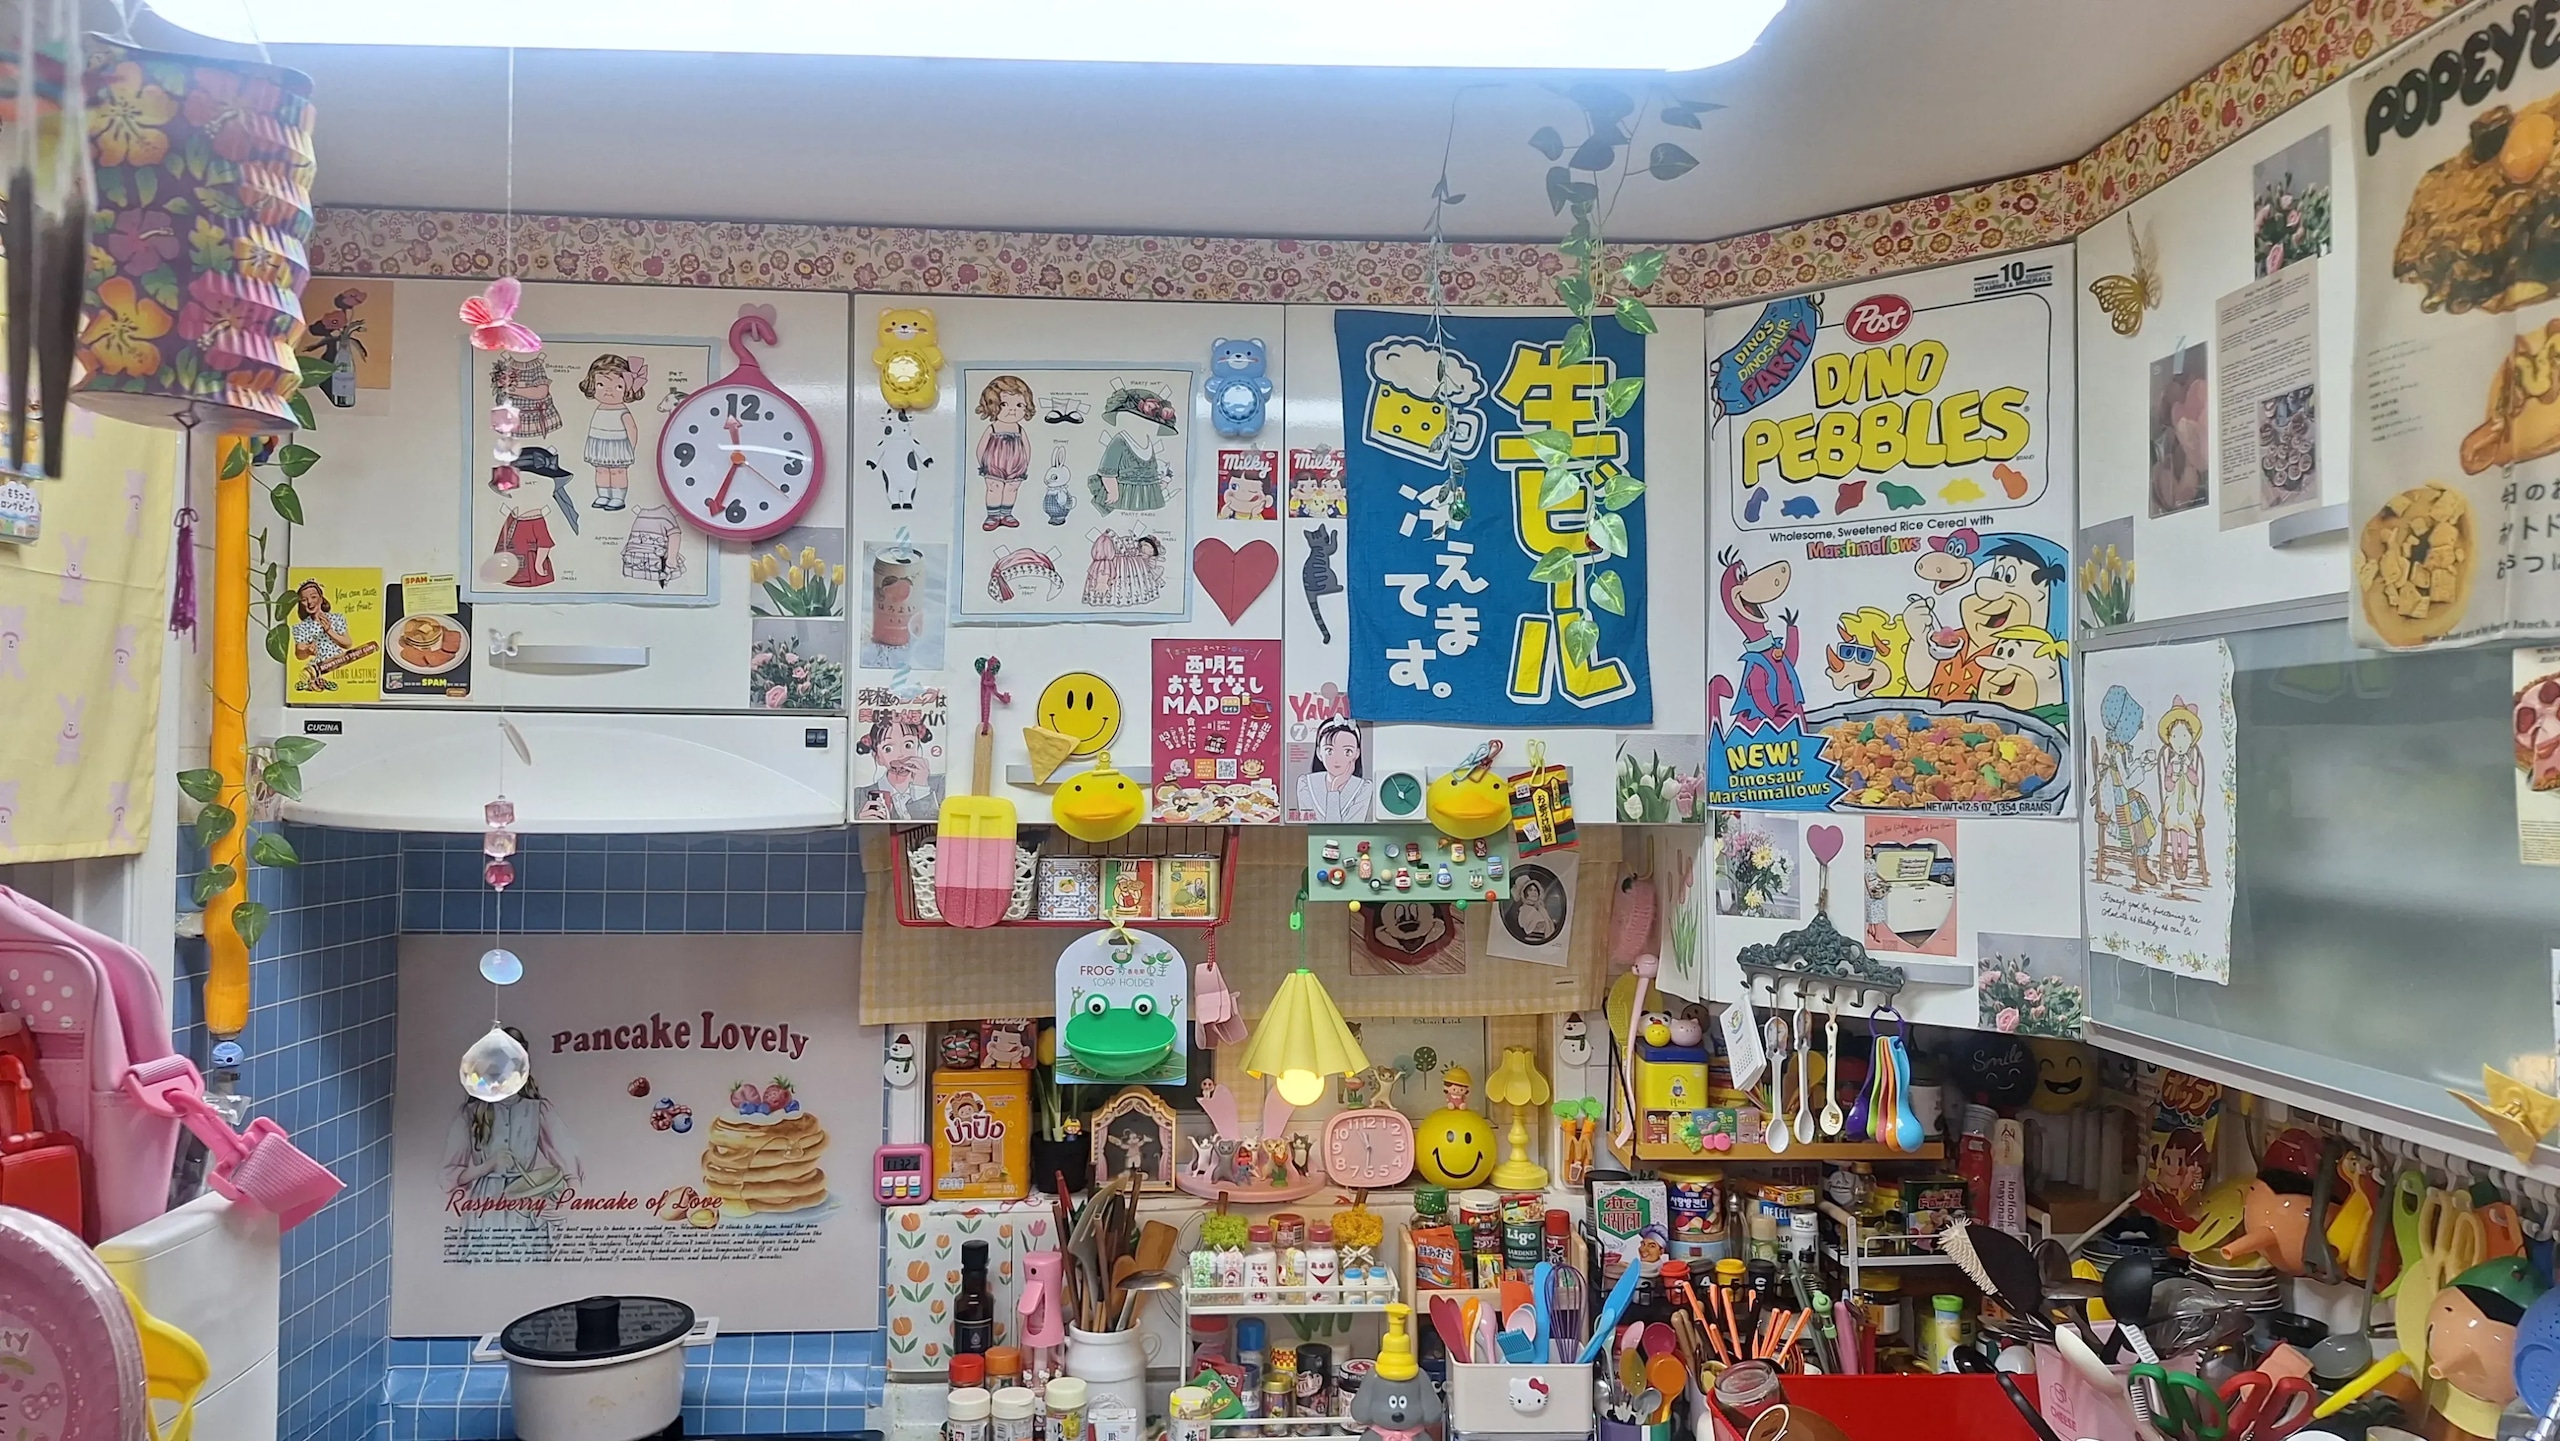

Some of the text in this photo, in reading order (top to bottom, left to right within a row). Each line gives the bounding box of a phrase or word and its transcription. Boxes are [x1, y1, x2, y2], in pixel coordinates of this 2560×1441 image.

[1999, 261, 2025, 283] 10
[1973, 283, 2007, 293] VITAMINS
[2016, 275, 2052, 287] MINERALS
[1850, 303, 1907, 335] Post
[1733, 319, 1776, 366] DINO'S
[1737, 317, 1791, 382] DINOSAUR
[1740, 320, 1813, 405] PARTY
[1812, 339, 1949, 409] DINO
[725, 393, 761, 421] 12
[1742, 386, 2031, 489] PEBBLES
[673, 442, 696, 468] 9
[783, 450, 804, 476] 3
[1222, 453, 1273, 478] Milky
[1293, 453, 1344, 477] Milky
[725, 498, 747, 524] 6
[1769, 514, 1994, 543] Wholesome, Sweetened Rice Cereal with
[1806, 534, 1922, 560] Marshmallows
[405, 576, 428, 585] SPAM
[335, 588, 378, 604] You can taste
[344, 600, 373, 613] the fruit
[333, 668, 377, 680] LONG LASTING
[1185, 655, 1246, 676] 西明石
[421, 678, 447, 687] SPAM
[1167, 674, 1265, 696] おもてなし
[1162, 695, 1220, 715] MAP
[306, 723, 340, 732] CUCINA
[1293, 724, 1306, 740] 7
[1726, 739, 1800, 773] NEW!
[1727, 770, 1804, 788] Dinosaur
[1709, 781, 1831, 804] Marshmallows
[1926, 803, 1942, 812] NET
[2019, 802, 2051, 813] GRAMS)
[1115, 860, 1141, 873] PIZZA
[1080, 965, 1115, 976] FROG
[1092, 978, 1155, 987] SOAP HOLDER
[550, 1010, 810, 1060] Pancake Lovely
[1971, 1044, 2024, 1072] Smile
[1348, 1118, 1361, 1130] 11
[1361, 1117, 1376, 1128] 12
[1380, 1117, 1388, 1129] 1
[1390, 1122, 1401, 1135] 2
[1333, 1128, 1349, 1140] 10
[1332, 1142, 1343, 1153] 9
[1394, 1139, 1405, 1151] 3
[1335, 1158, 1347, 1170] 8
[1379, 1164, 1390, 1176] 5
[1391, 1156, 1403, 1168] 4
[1350, 1166, 1360, 1178] 7
[1363, 1166, 1375, 1178] 6
[445, 1185, 725, 1219] Raspberry Pancake of Love
[2007, 1181, 2017, 1228] knoflook
[1506, 1228, 1537, 1246] Ligo
[1507, 1248, 1538, 1257] SARDINES
[2050, 1403, 2078, 1433] CHEESE
